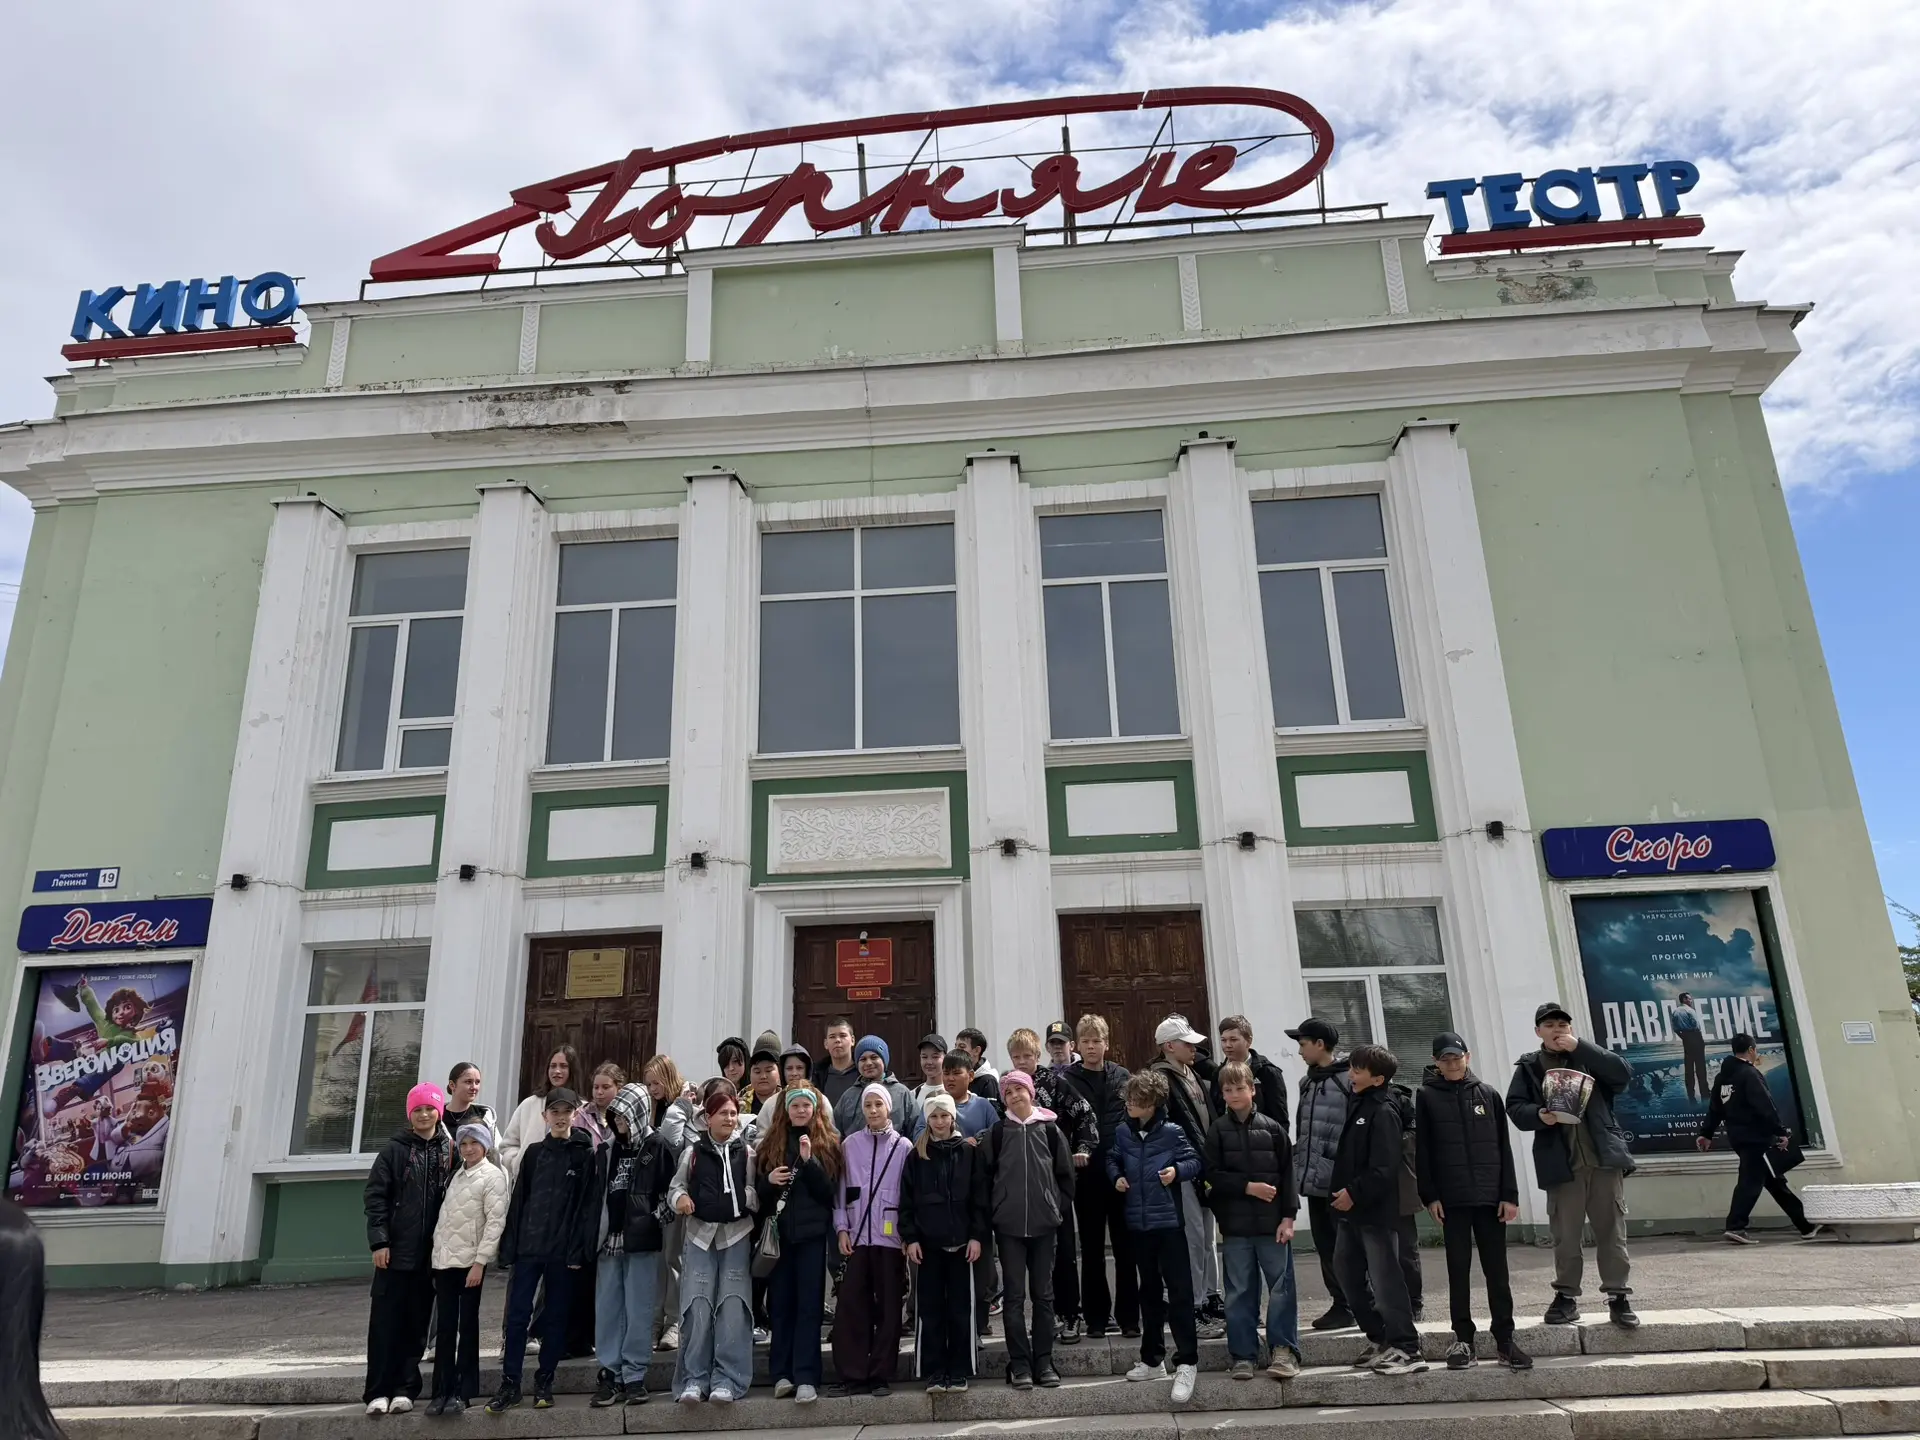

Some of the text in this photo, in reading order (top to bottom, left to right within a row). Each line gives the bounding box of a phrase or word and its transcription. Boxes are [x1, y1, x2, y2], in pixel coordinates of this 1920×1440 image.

[1426, 160, 1699, 234] ТЕАТР
[70, 271, 300, 342] КИНО
[1606, 827, 1712, 870] Скоро
[51, 878, 87, 888] Ленина
[101, 873, 115, 883] 19
[1641, 912, 1666, 920] ЭНДРЮ
[51, 908, 179, 945] Детям
[1656, 933, 1685, 942] ОДИН
[1651, 952, 1697, 961] ПРОГНОЗ
[1642, 971, 1713, 981] ИЗМЕНИТ МИР
[35, 1027, 176, 1092] ЗВЕРОЛЮЦИЯ
[1674, 1120, 1698, 1128] КИНО
[45, 1171, 132, 1182] В КИНО С 11 ИЮНЯ
